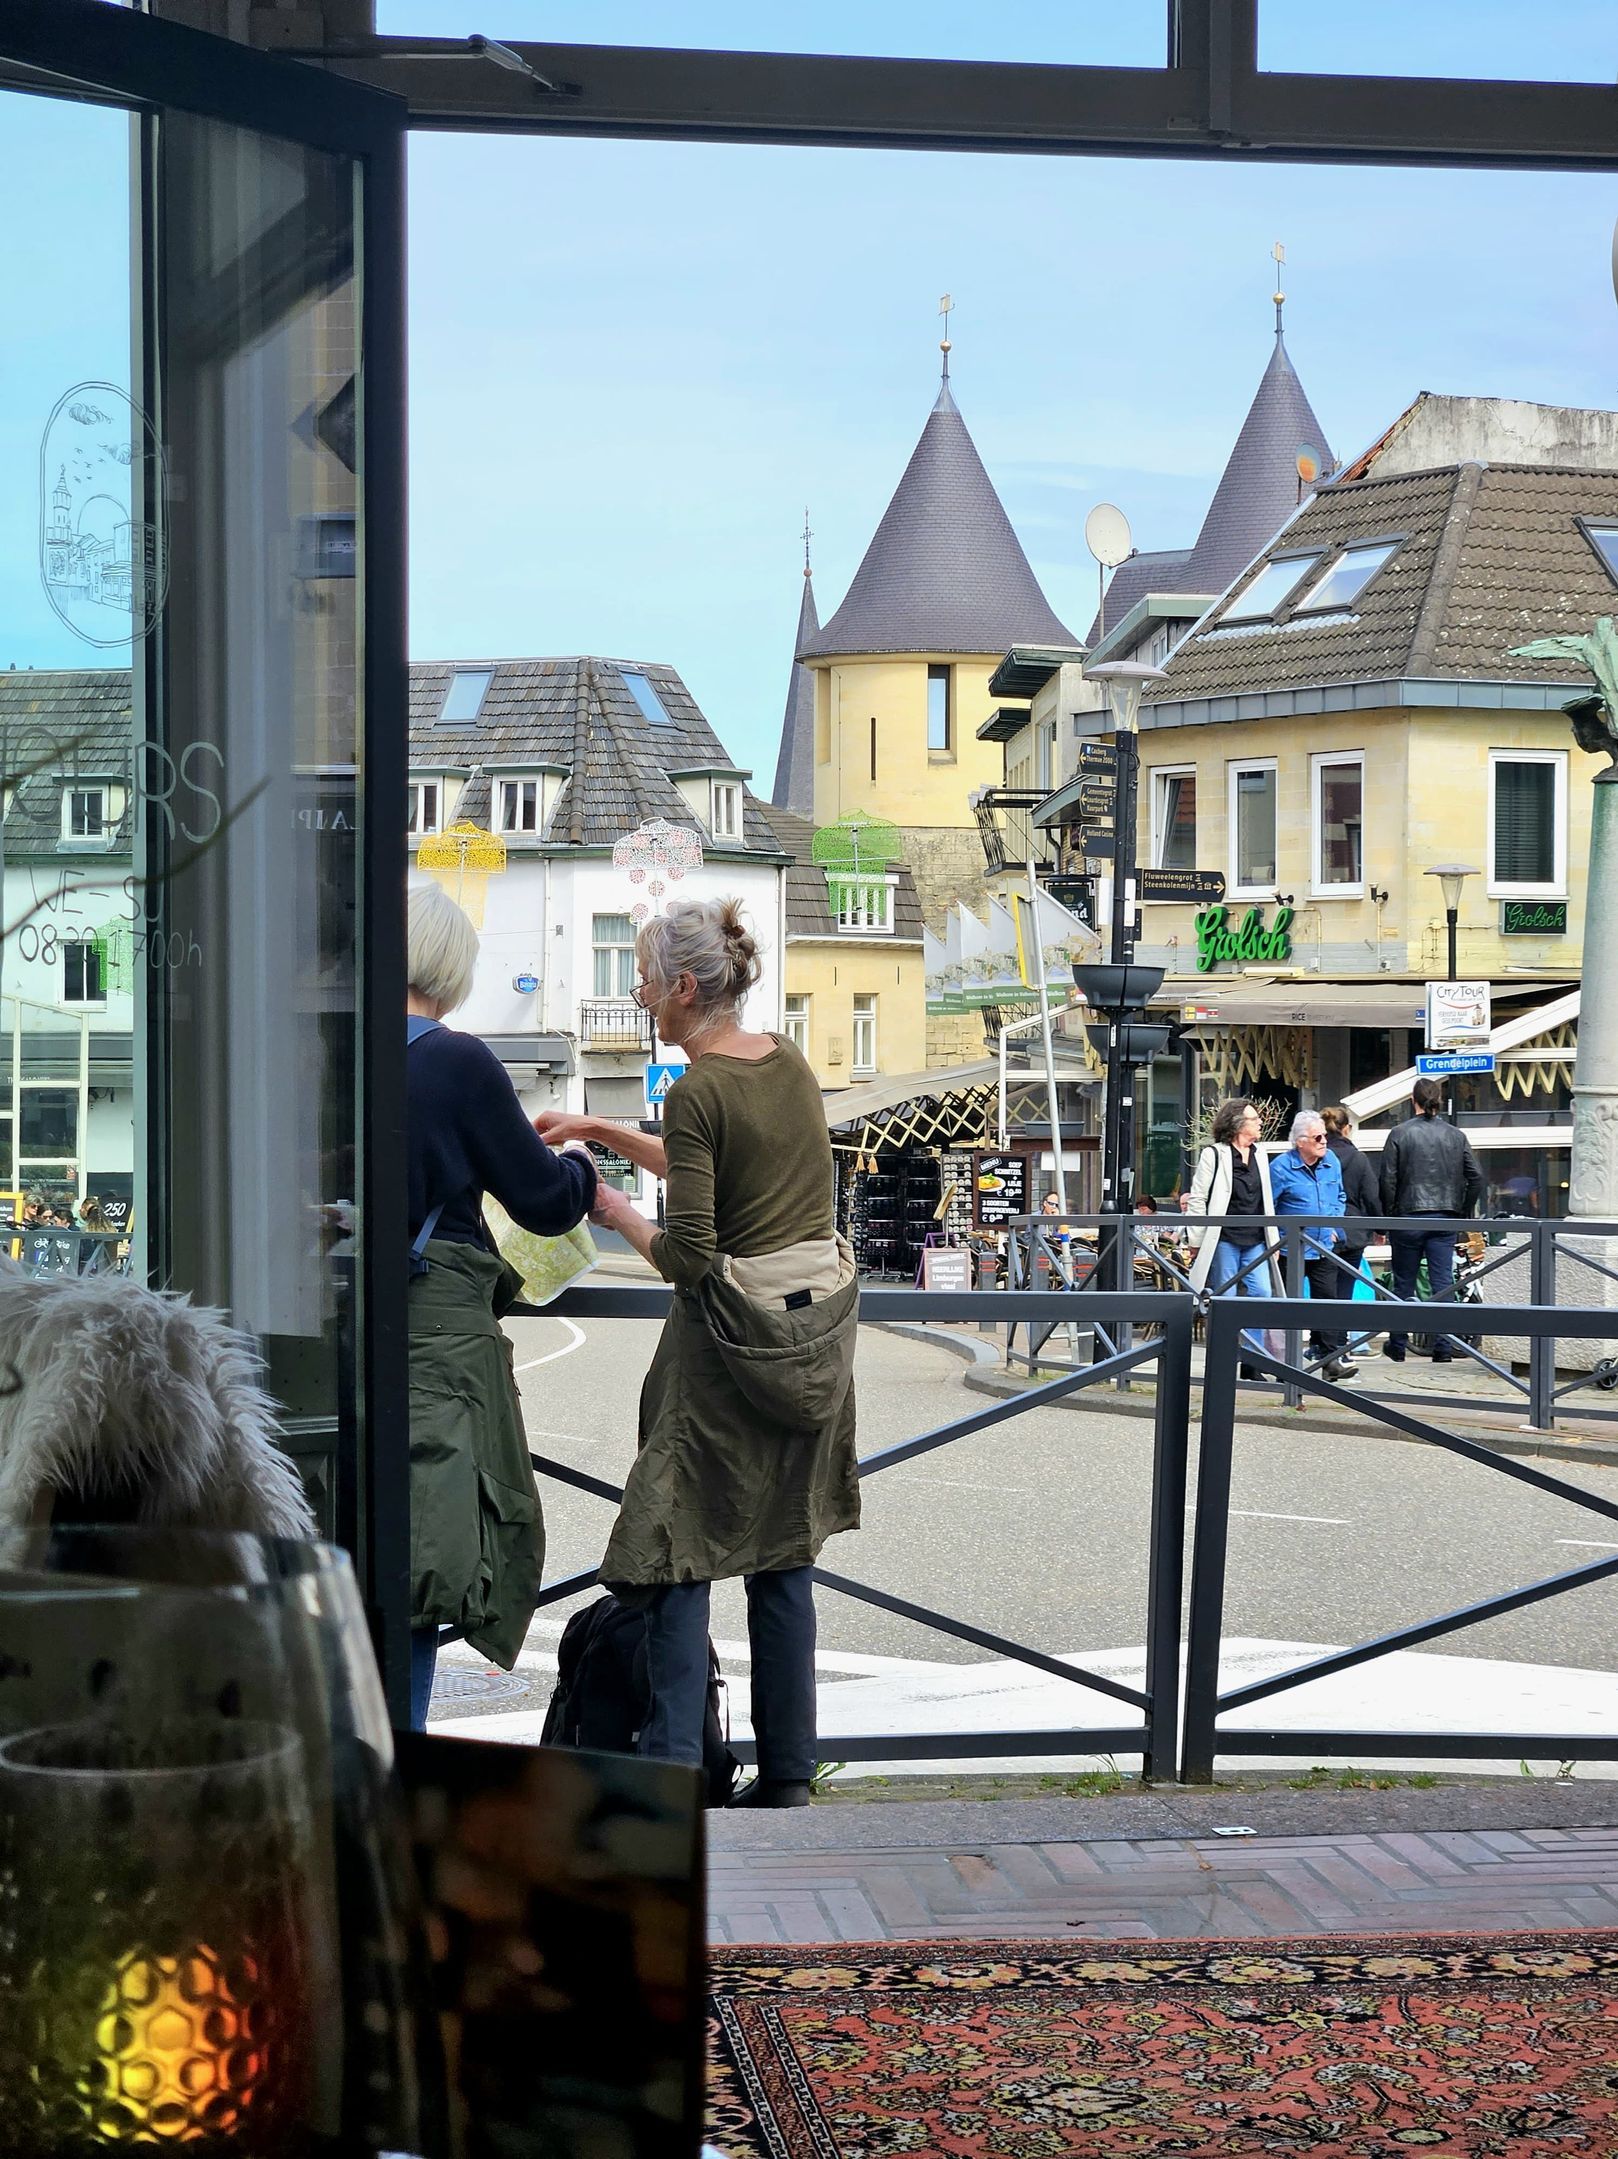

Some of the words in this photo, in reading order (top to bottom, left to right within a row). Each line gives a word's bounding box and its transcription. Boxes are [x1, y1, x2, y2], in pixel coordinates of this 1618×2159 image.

[1144, 872, 1193, 882] Fluweelengrot
[1144, 881, 1195, 891] Steenkolenmijn
[1506, 904, 1565, 931] Grolsch
[1194, 906, 1292, 972] Grolsch
[1291, 1013, 1306, 1021] RICE
[1426, 1057, 1487, 1070] Grendelplein
[980, 1158, 1000, 1171] MENU
[104, 1202, 127, 1217] 250
